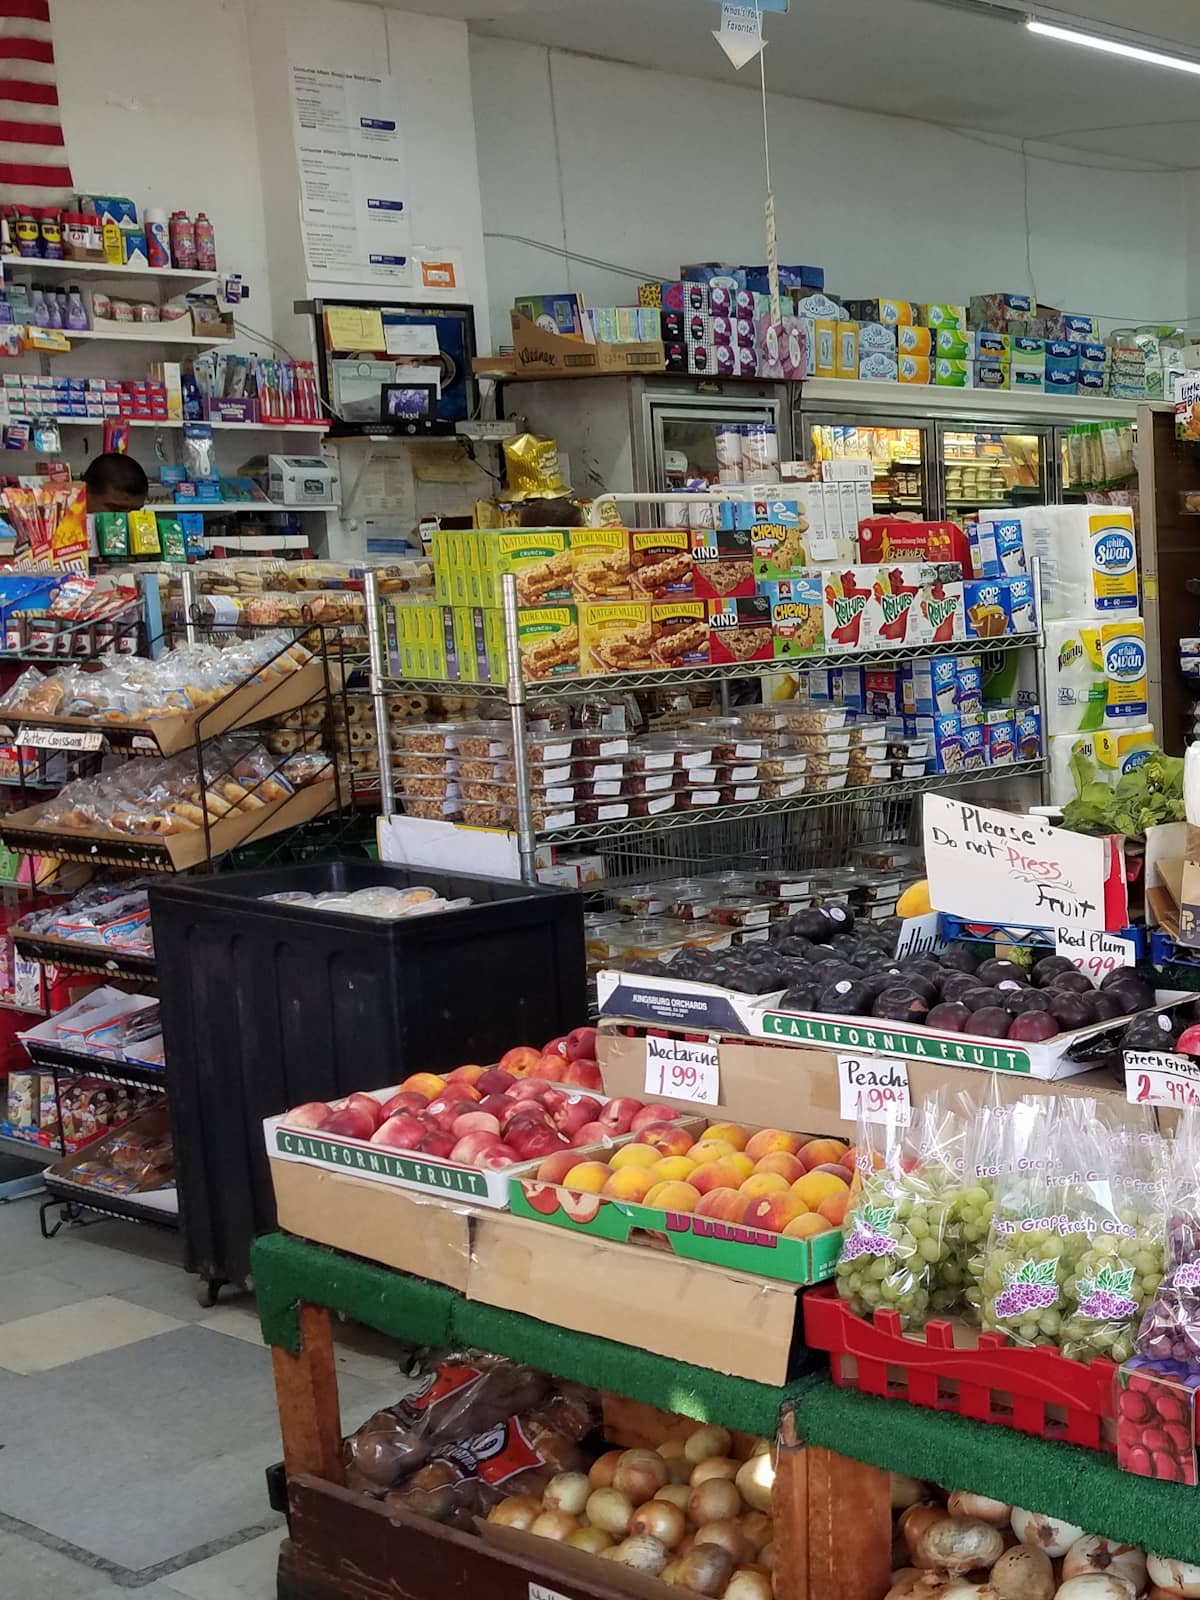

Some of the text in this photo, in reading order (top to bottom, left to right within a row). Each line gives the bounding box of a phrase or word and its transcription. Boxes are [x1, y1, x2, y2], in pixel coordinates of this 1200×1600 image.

[1181, 382, 1200, 398] Little
[501, 534, 562, 550] NATURE VALLEY
[572, 532, 622, 546] ATURE VALLEY
[635, 533, 687, 547] NATURE VALLEY
[692, 547, 719, 561] KIND
[1097, 544, 1131, 566] Swan
[519, 609, 568, 623] TURE VALLEY
[589, 606, 646, 622] NATURE VALLEY
[654, 604, 702, 618] NATURE VALLEY
[708, 614, 738, 627] KIND
[1057, 643, 1083, 672] Bounty
[1108, 652, 1142, 673] Swan
[1103, 737, 1109, 750] 8
[931, 826, 958, 848] Do
[965, 838, 1000, 858] not
[1035, 883, 1096, 919] Fruit
[1057, 926, 1126, 956] Red Plum
[773, 1017, 1018, 1070] CALIFORNIA FRUIT
[648, 1040, 719, 1067] Nectarine
[1123, 1051, 1164, 1068] Green
[284, 1135, 477, 1194] CALIFORNIA FRUIT
[1020, 1214, 1068, 1230] Grape
[1058, 1218, 1097, 1237] Fresh
